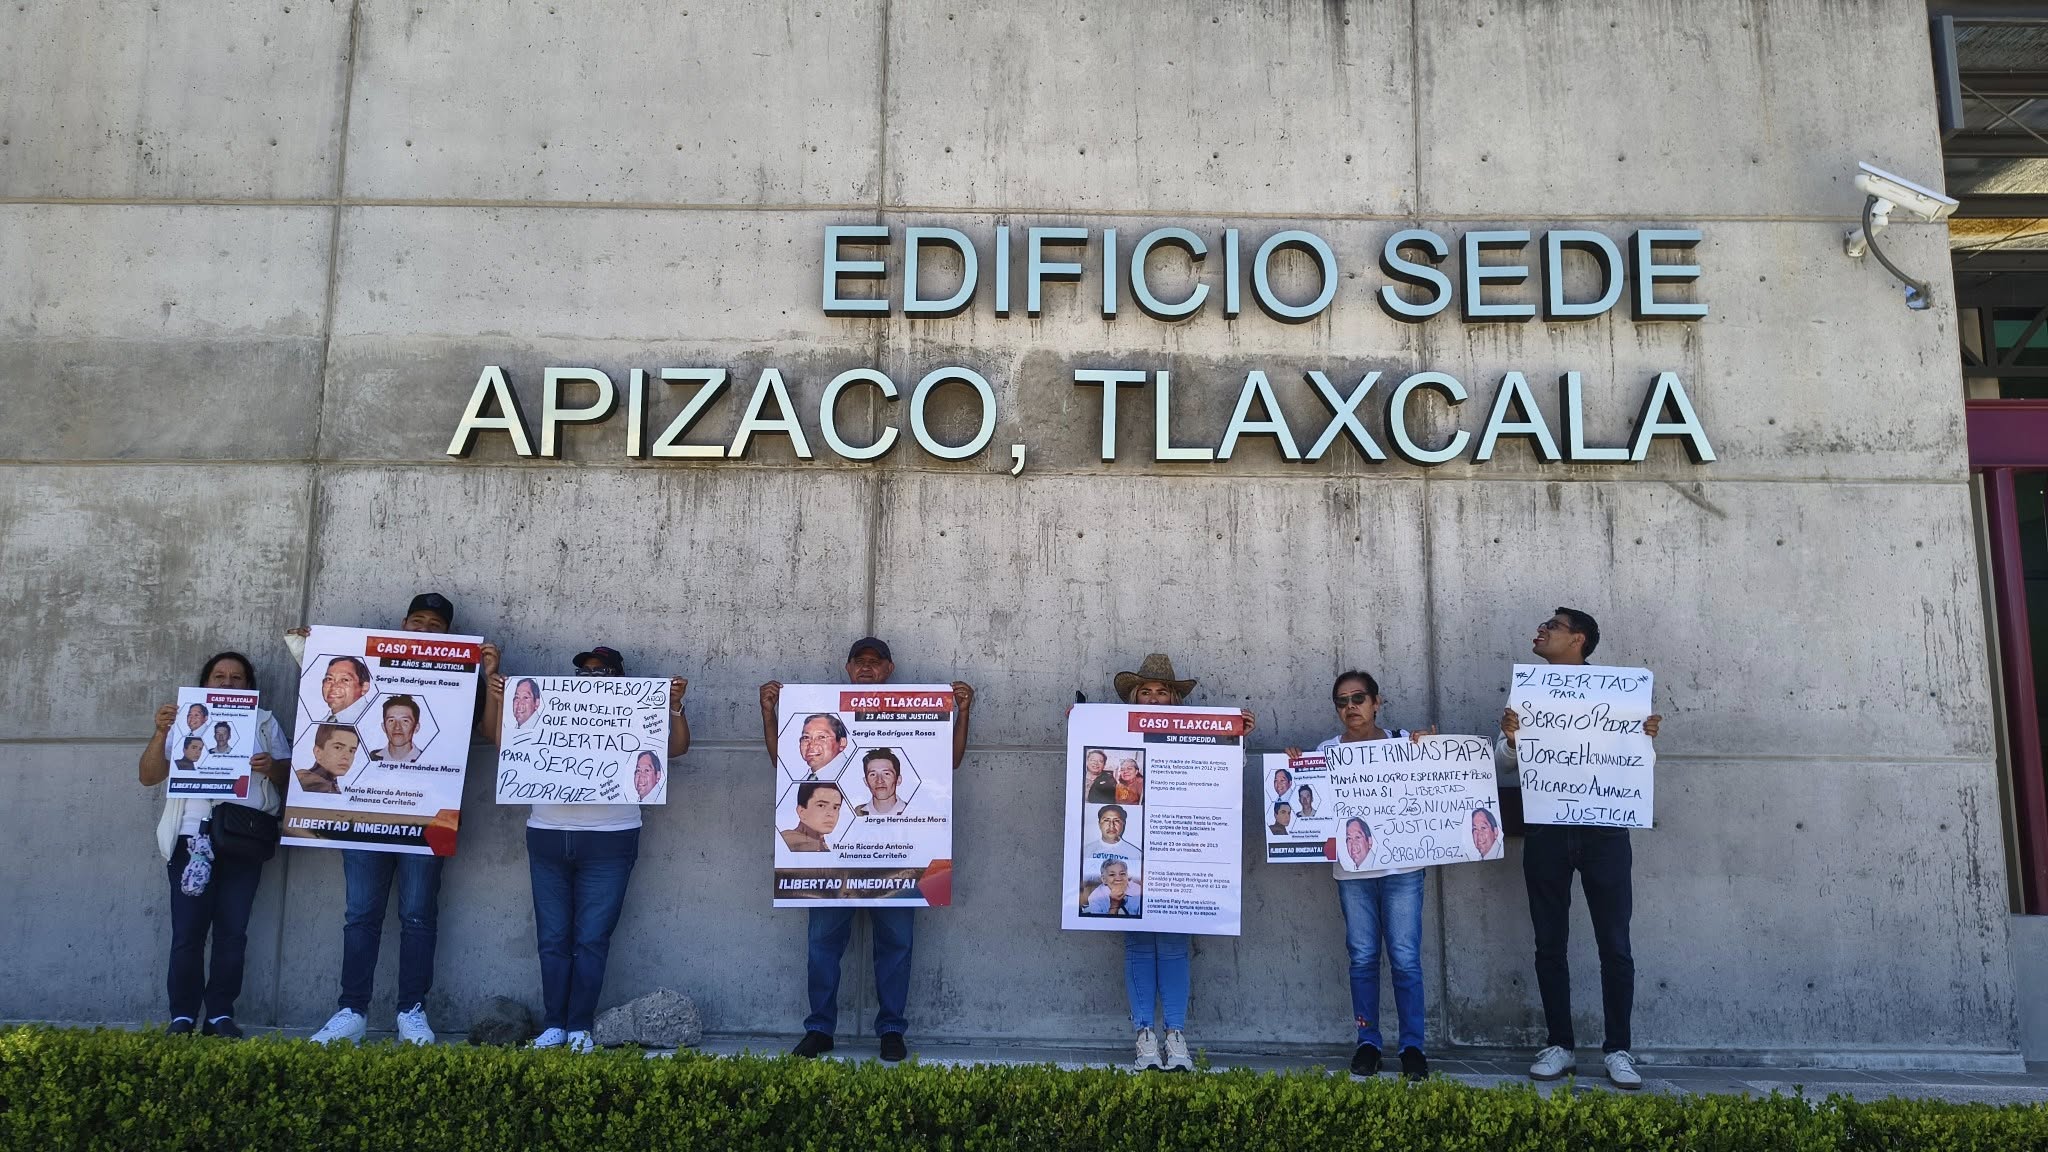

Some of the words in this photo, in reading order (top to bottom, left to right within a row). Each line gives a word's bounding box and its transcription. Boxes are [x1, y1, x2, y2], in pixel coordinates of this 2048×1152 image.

[823, 226, 1338, 321] EDIFICIO
[1380, 229, 1708, 322] SEDE
[447, 365, 1026, 477] APIZACO,
[1074, 369, 1716, 466] TLAXCALA
[376, 643, 407, 654] CASO
[411, 645, 471, 658] TLAXCALA
[401, 659, 419, 668] AÑOS
[421, 661, 432, 669] SIN
[434, 662, 464, 671] JUSTICIA
[376, 675, 399, 683] Sergio
[400, 677, 437, 686] Rodríguez
[542, 679, 592, 694] LLEVO
[593, 681, 642, 696] PRESO
[637, 680, 667, 708] 23
[1549, 688, 1586, 700] PARA
[549, 697, 572, 712] POR
[574, 703, 588, 713] UN
[589, 704, 633, 716] DELITO
[850, 697, 880, 708] CASO
[884, 697, 944, 708] TLAXCALA
[542, 715, 568, 727] QUE
[571, 717, 588, 727] NO
[589, 718, 631, 728] COMETI
[876, 712, 894, 720] AÑOS
[1521, 701, 1591, 730] SERGIO
[1139, 718, 1169, 729] CASO
[1172, 719, 1233, 731] TLAXCALA
[531, 728, 641, 752] LIBERTAD
[852, 730, 876, 738] Sergio
[877, 729, 914, 738] Rodríguez
[1179, 736, 1217, 744] DESPEDIDA
[1355, 746, 1379, 765] TE
[1381, 739, 1441, 763] RINDAS
[1443, 739, 1491, 762] PAPÁ
[1519, 738, 1578, 766] JORGE
[1579, 742, 1645, 767] HERNANDEZ
[378, 762, 399, 771] Jorge
[400, 763, 439, 772] Hernández
[501, 749, 531, 763] PARA
[533, 748, 619, 779] SERGIO
[1330, 772, 1358, 785] MAMÁ
[1359, 774, 1374, 783] NO
[1377, 772, 1408, 783] LOGRO
[1410, 770, 1461, 782] ESPERARTE
[1469, 769, 1492, 780] PERO
[1522, 768, 1587, 793] RICARDO
[1589, 775, 1642, 800] ALMANZA
[344, 786, 365, 794] Mario
[366, 788, 394, 796] Ricardo
[395, 790, 424, 798] Antonio
[499, 769, 597, 803] RODRIGUEZ
[1334, 788, 1349, 798] TU
[1353, 787, 1378, 798] HIJA
[1381, 786, 1392, 798] SI
[349, 796, 381, 804] Almanza
[382, 797, 416, 806] Cerriteño
[1333, 801, 1371, 817] PRESO
[1373, 804, 1396, 816] HACE
[1424, 800, 1439, 813] NI
[1440, 799, 1458, 813] UN
[1555, 799, 1637, 822] JUSTICIA
[288, 817, 350, 831] ¡LIBERTAD
[353, 822, 423, 837] INMEDIATA!
[865, 816, 886, 824] Jorge
[1383, 818, 1453, 835] JUSTICIA
[1379, 838, 1425, 864] SERGIO
[1419, 835, 1464, 860] RDGZ.
[779, 878, 842, 890] ¡LIBERTAD
[846, 878, 916, 890] INMEDIATA!
